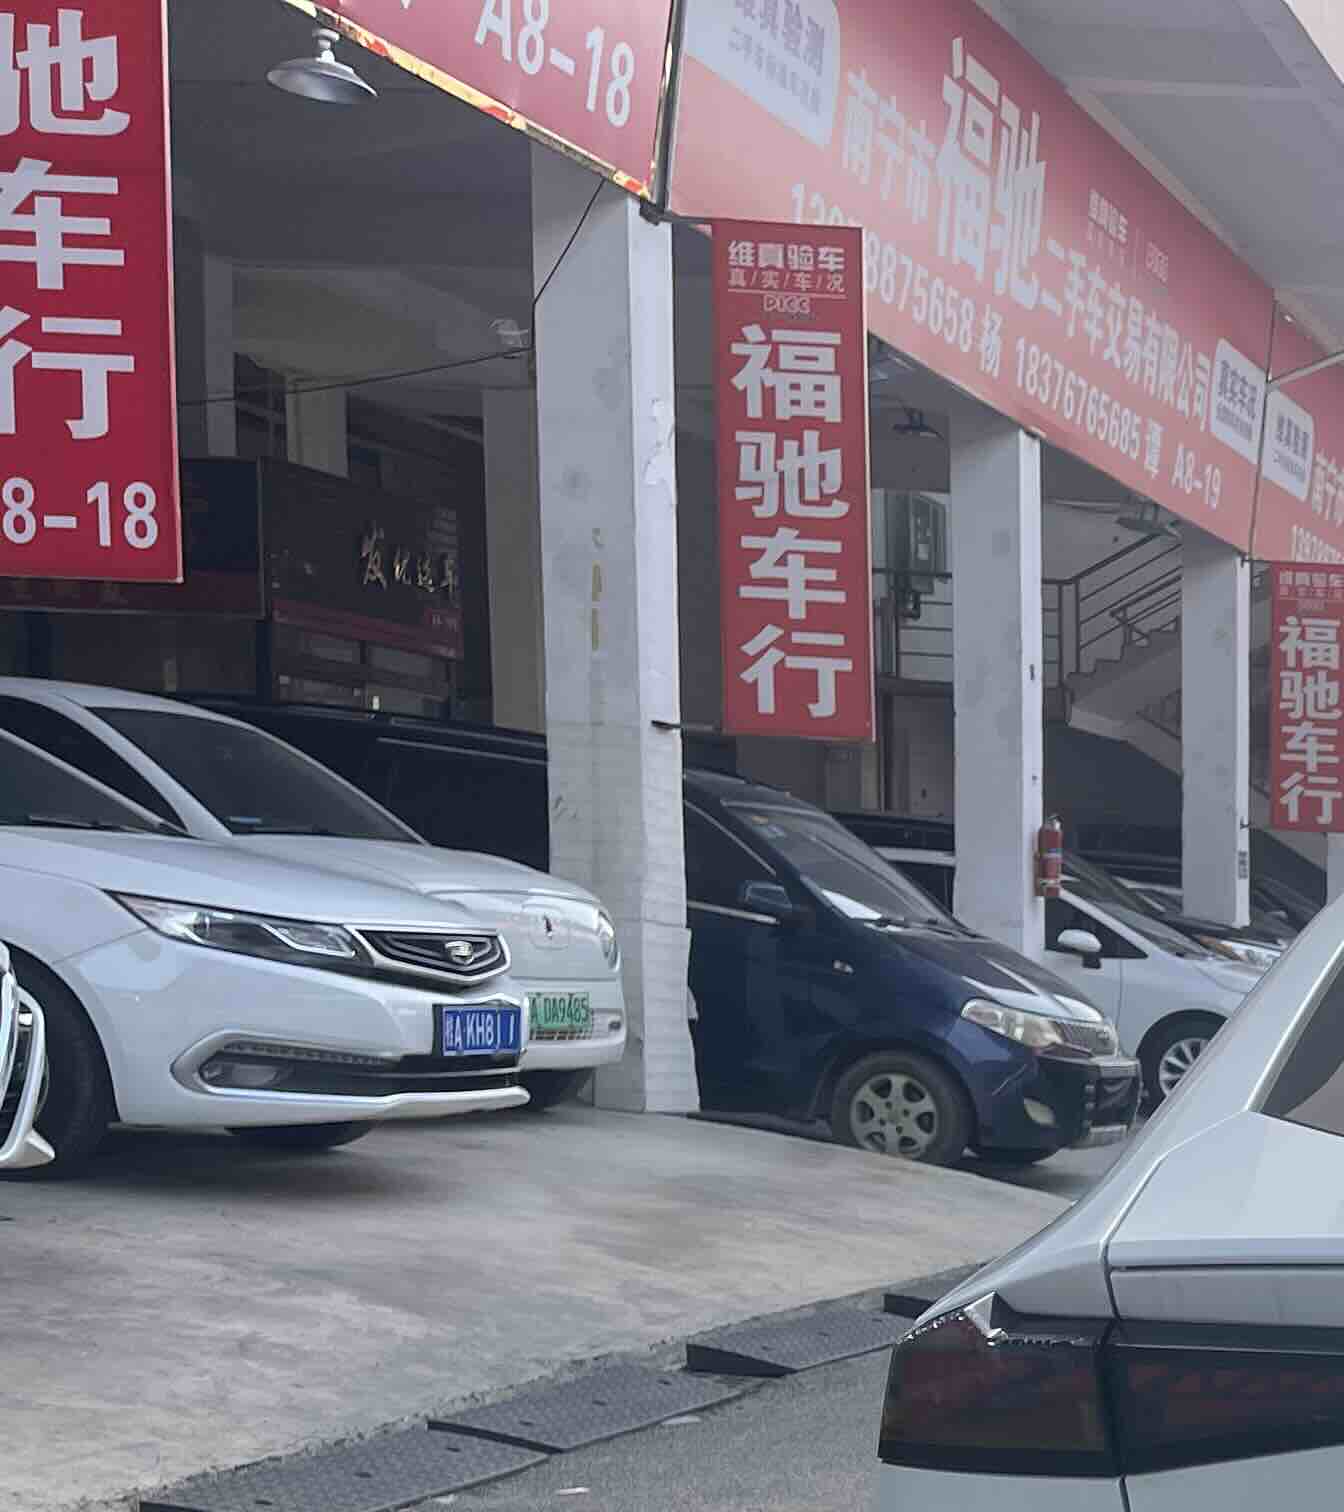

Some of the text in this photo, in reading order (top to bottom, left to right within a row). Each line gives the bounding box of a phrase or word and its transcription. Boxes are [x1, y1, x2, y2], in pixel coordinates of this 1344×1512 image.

[474, 0, 635, 127] A8-18
[728, 240, 845, 272] 维真验车
[730, 323, 850, 717] 福驰车行
[1279, 615, 1343, 826] 福驰车行
